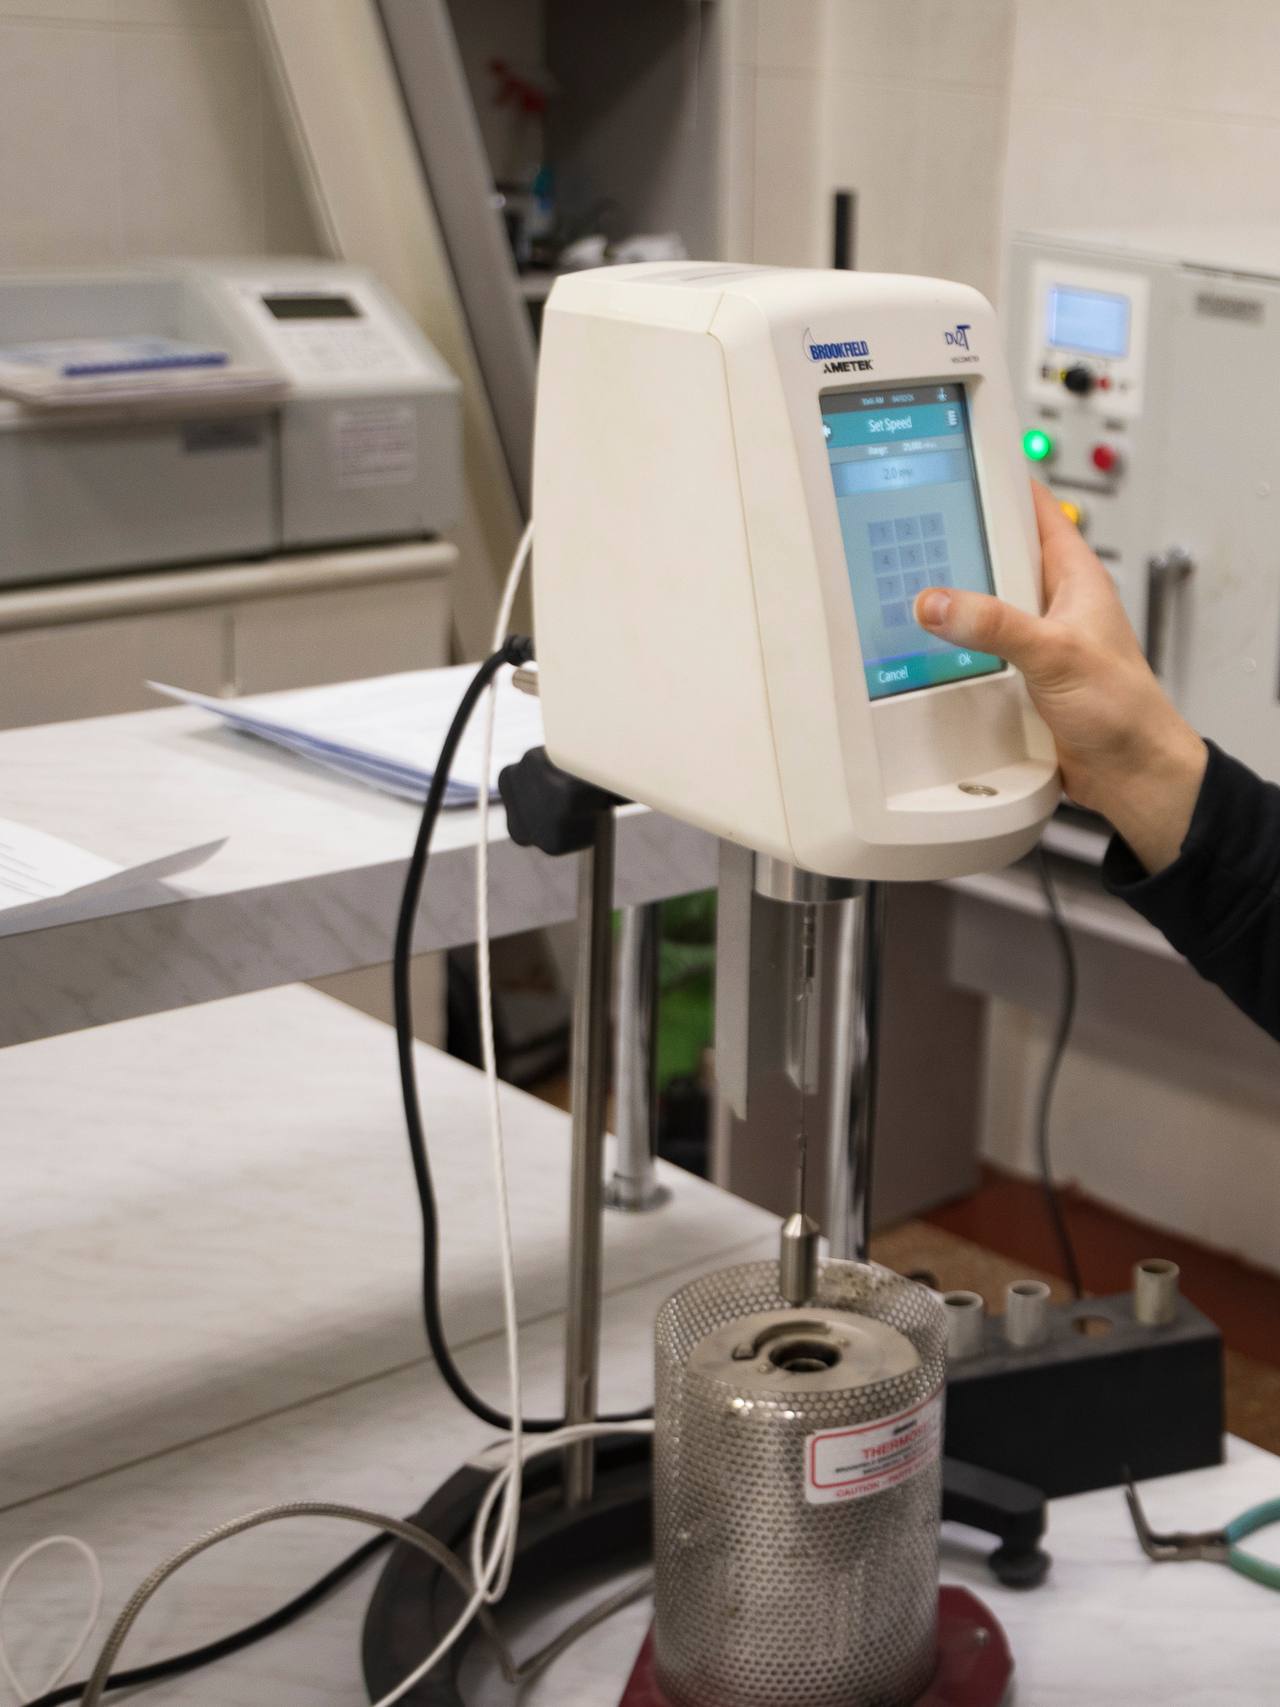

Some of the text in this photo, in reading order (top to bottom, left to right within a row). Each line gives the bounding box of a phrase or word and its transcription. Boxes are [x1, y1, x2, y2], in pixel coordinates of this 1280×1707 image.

[809, 341, 870, 361] BROOKFIELD
[823, 360, 873, 374] AMETEK
[868, 416, 913, 434] Set Speed
[877, 666, 909, 683] Cancel
